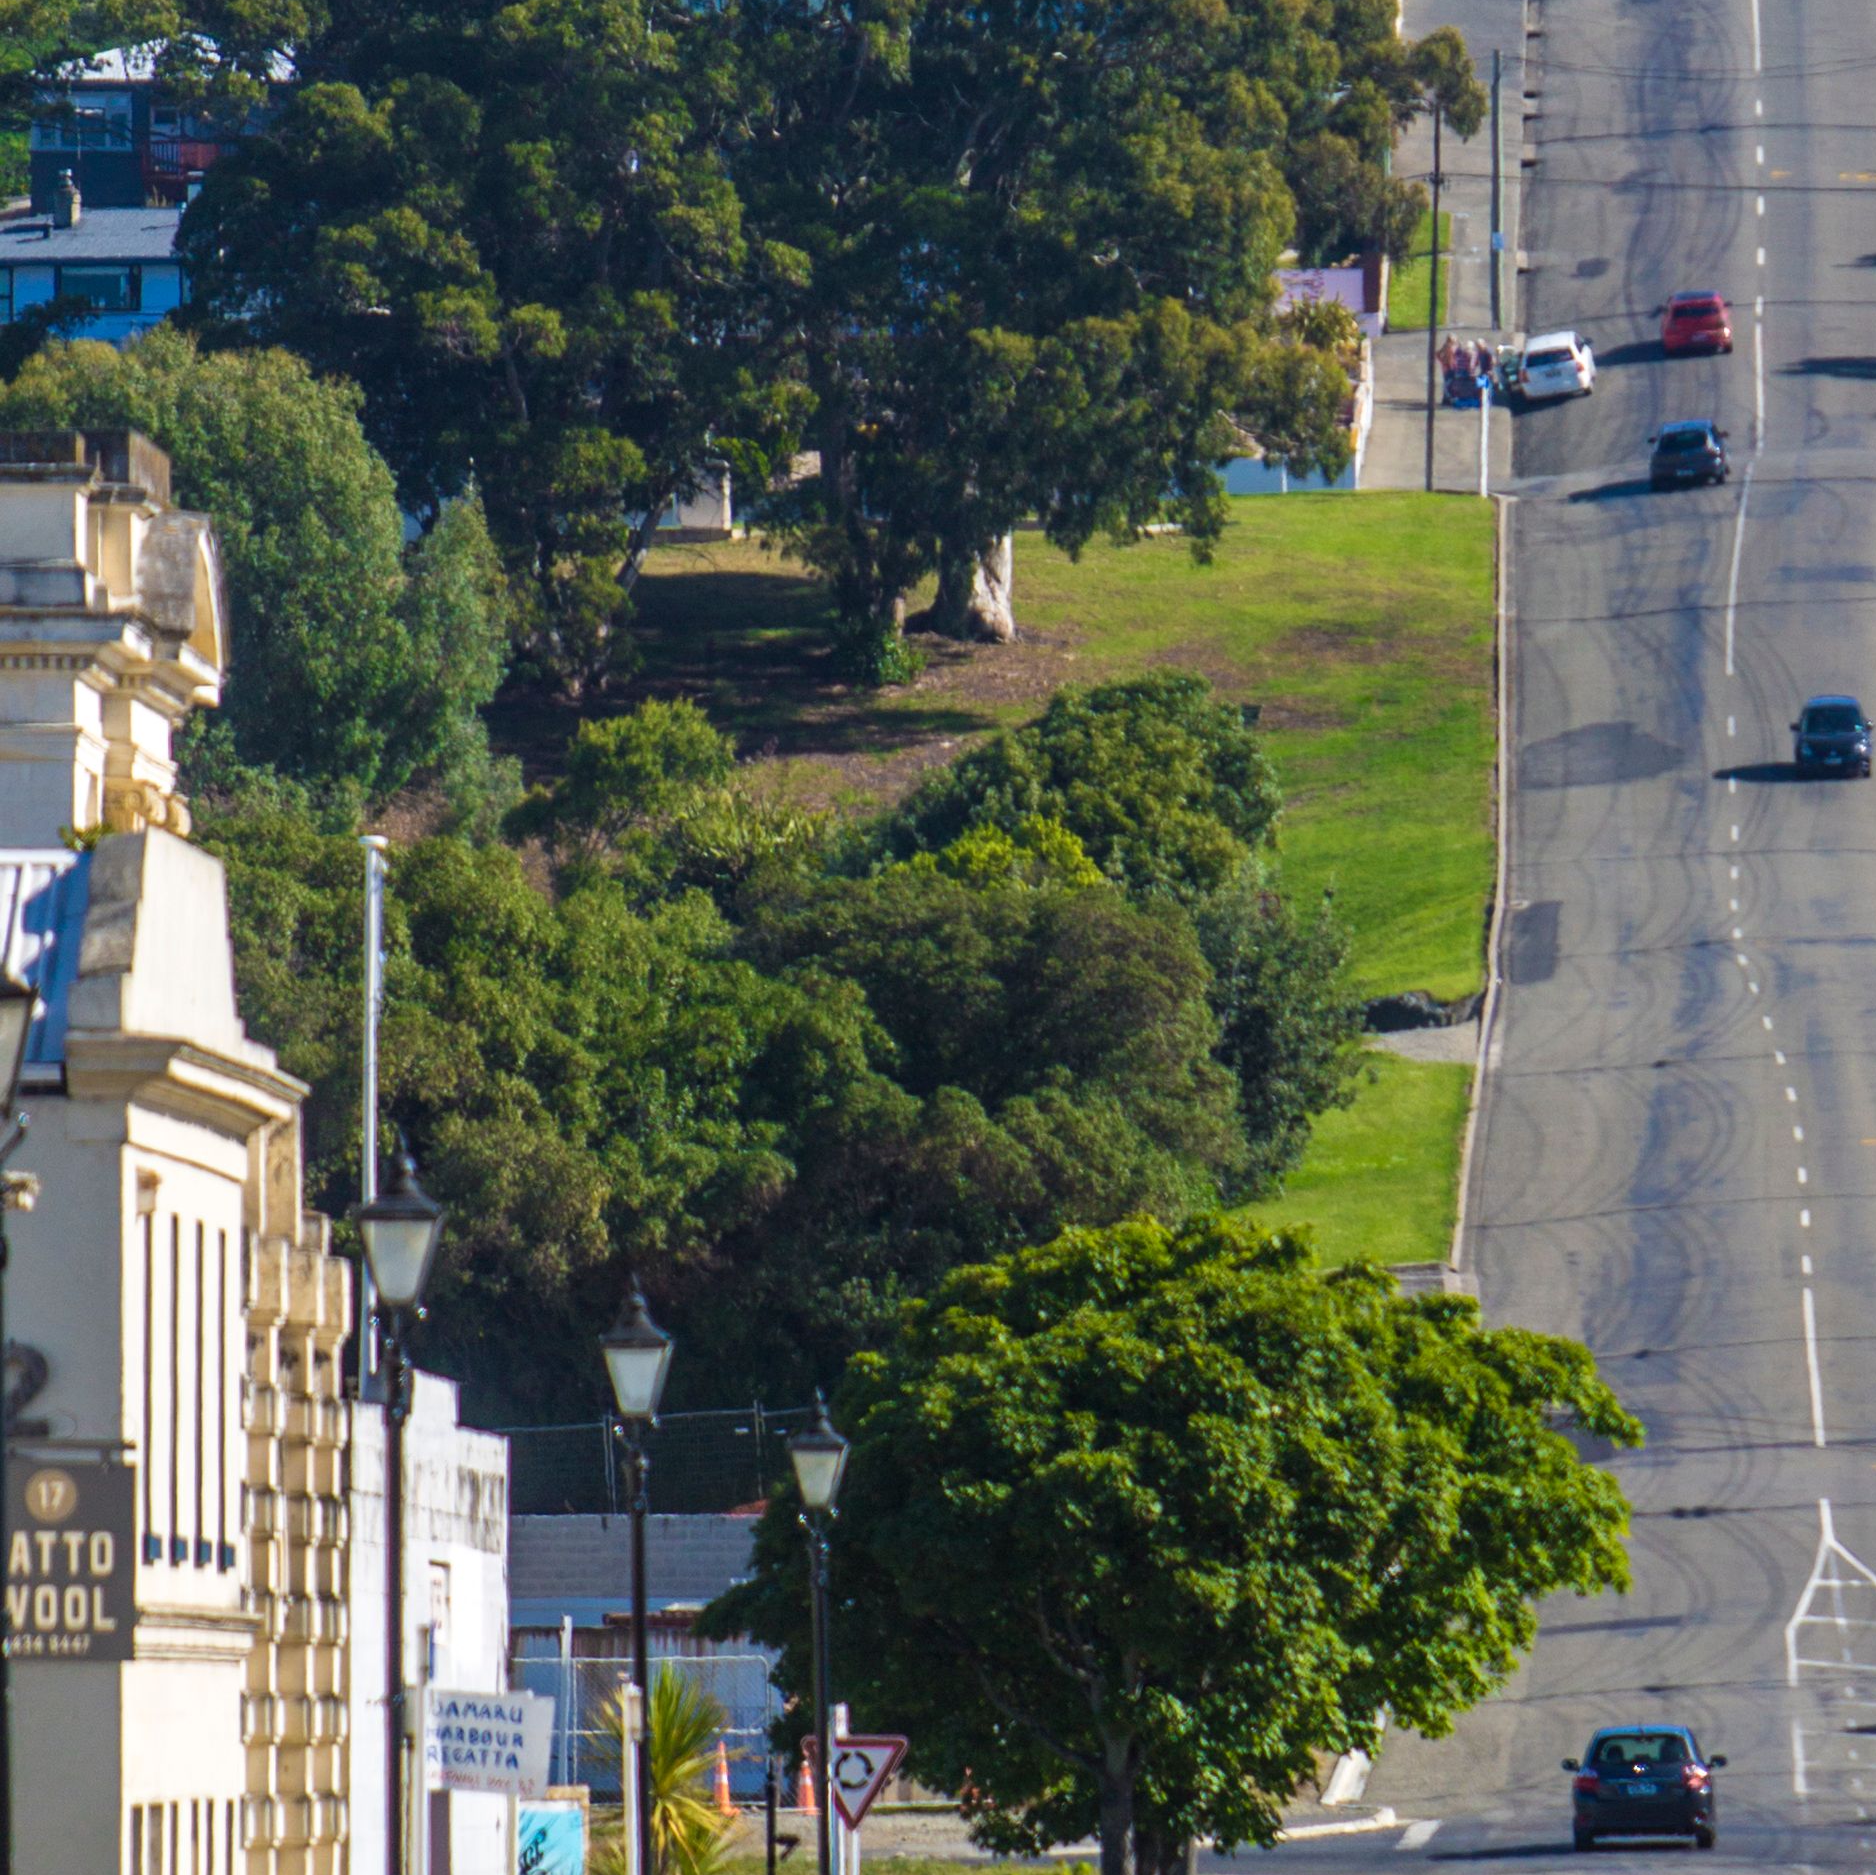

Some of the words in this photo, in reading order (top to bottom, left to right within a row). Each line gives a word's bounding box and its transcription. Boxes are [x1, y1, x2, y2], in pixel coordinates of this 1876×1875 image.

[38, 1481, 65, 1509] 17
[426, 1726, 524, 1749] HARBOUR
[426, 1745, 519, 1770] REGATTA
